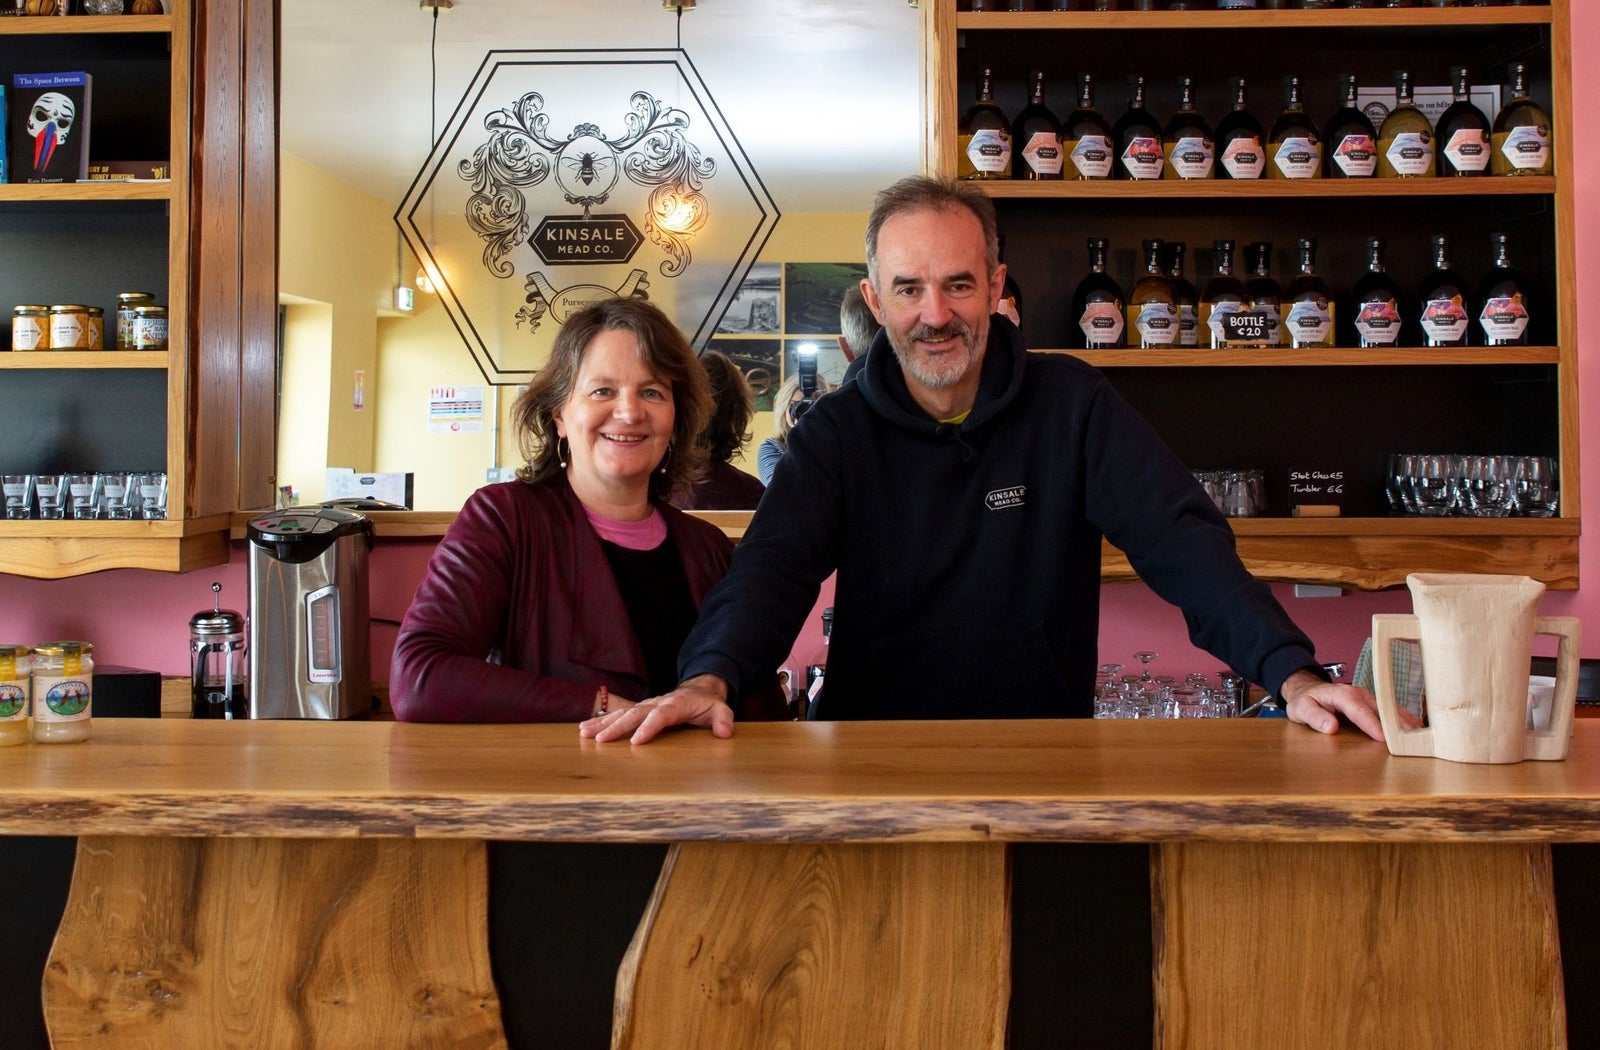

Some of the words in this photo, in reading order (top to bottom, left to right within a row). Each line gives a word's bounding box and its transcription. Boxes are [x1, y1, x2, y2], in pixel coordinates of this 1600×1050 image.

[33, 77, 52, 86] Space
[546, 228, 625, 241] KINSALE
[558, 245, 590, 253] MEAD
[594, 245, 613, 253] CO.
[1230, 316, 1264, 326] BOTTLE
[1291, 472, 1310, 480] Shot
[1290, 484, 1321, 493] Tumbler
[989, 489, 1025, 501] KINSALE
